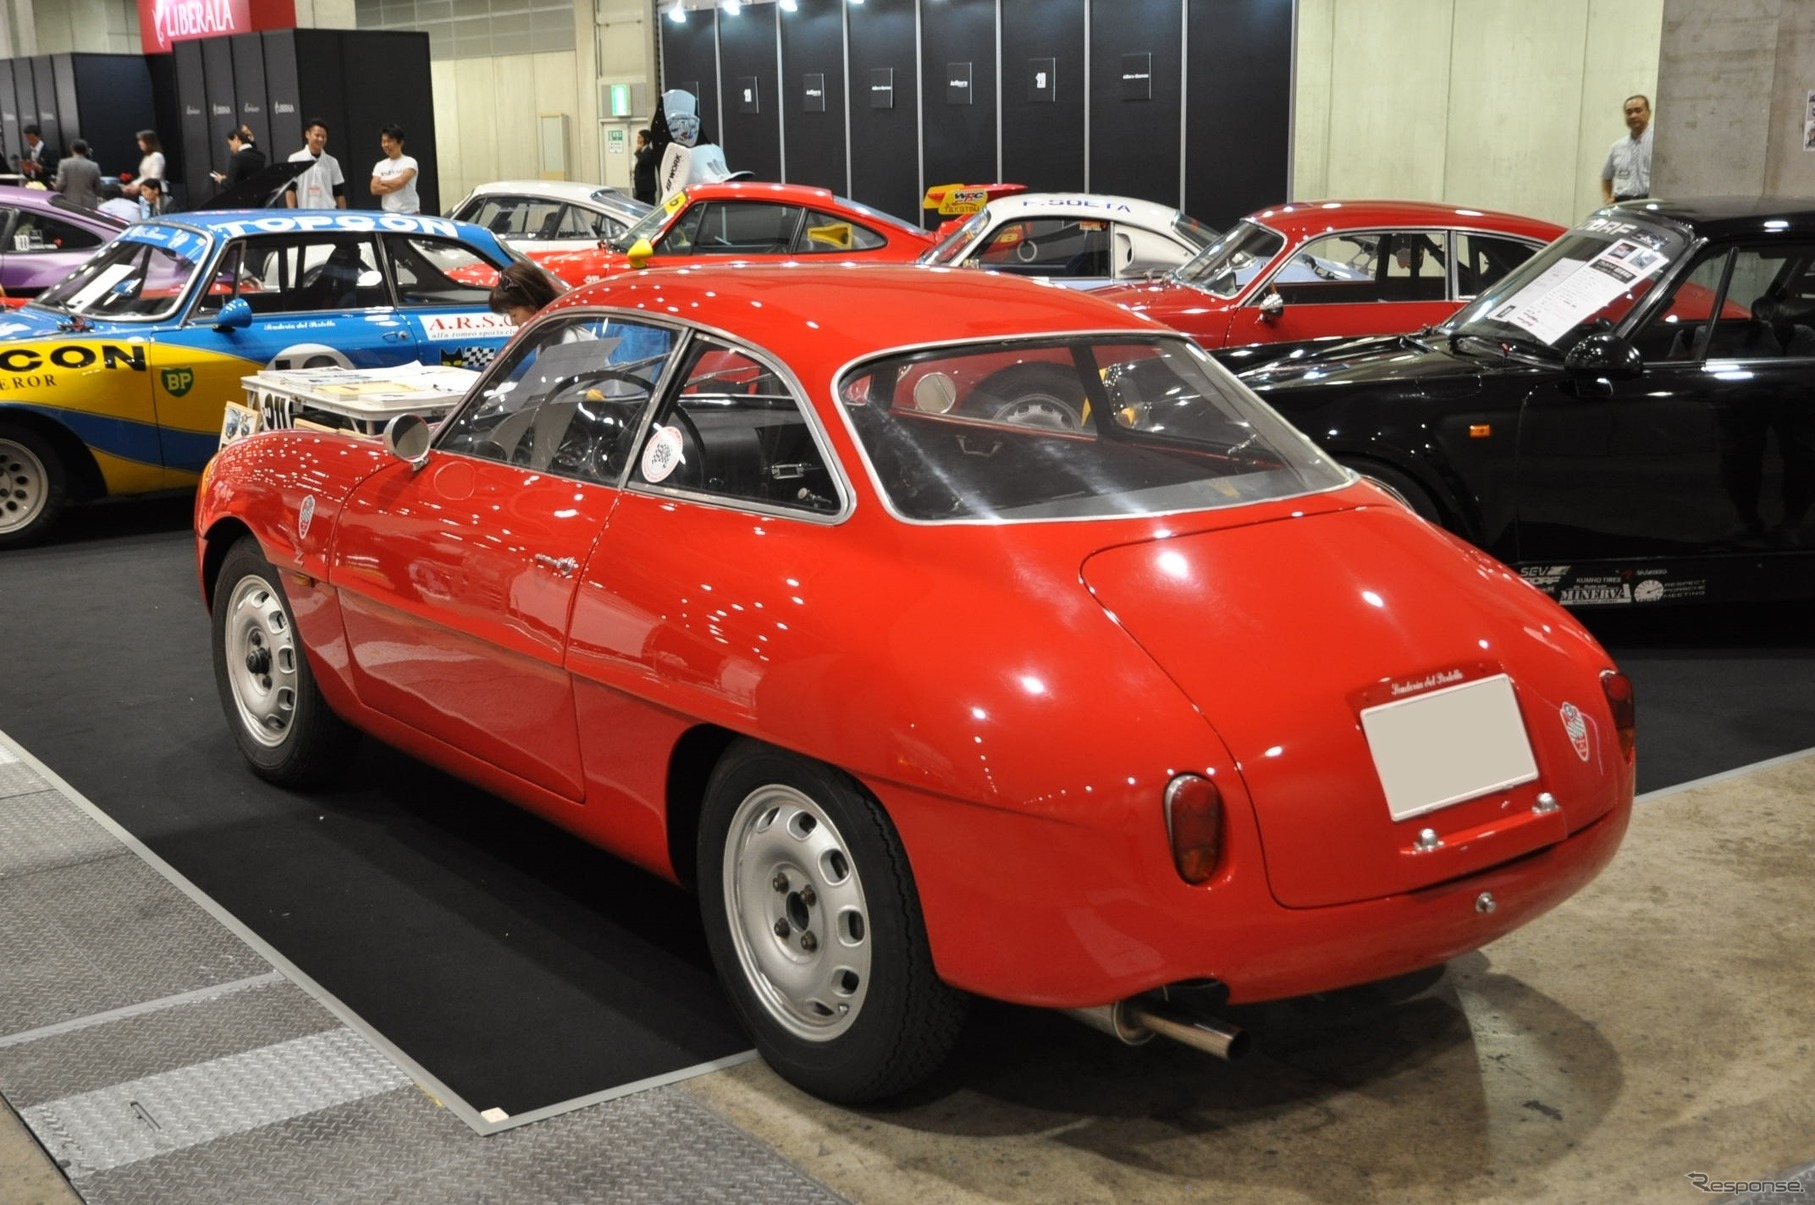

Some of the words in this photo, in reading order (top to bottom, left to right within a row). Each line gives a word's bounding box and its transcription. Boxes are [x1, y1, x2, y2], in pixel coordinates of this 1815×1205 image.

[164, 0, 235, 37] LIBERALA
[670, 153, 682, 179] WORK
[0, 345, 147, 372] CON
[166, 372, 192, 391] BP
[1520, 566, 1549, 577] SEV
[1560, 583, 1631, 600] MINERVA
